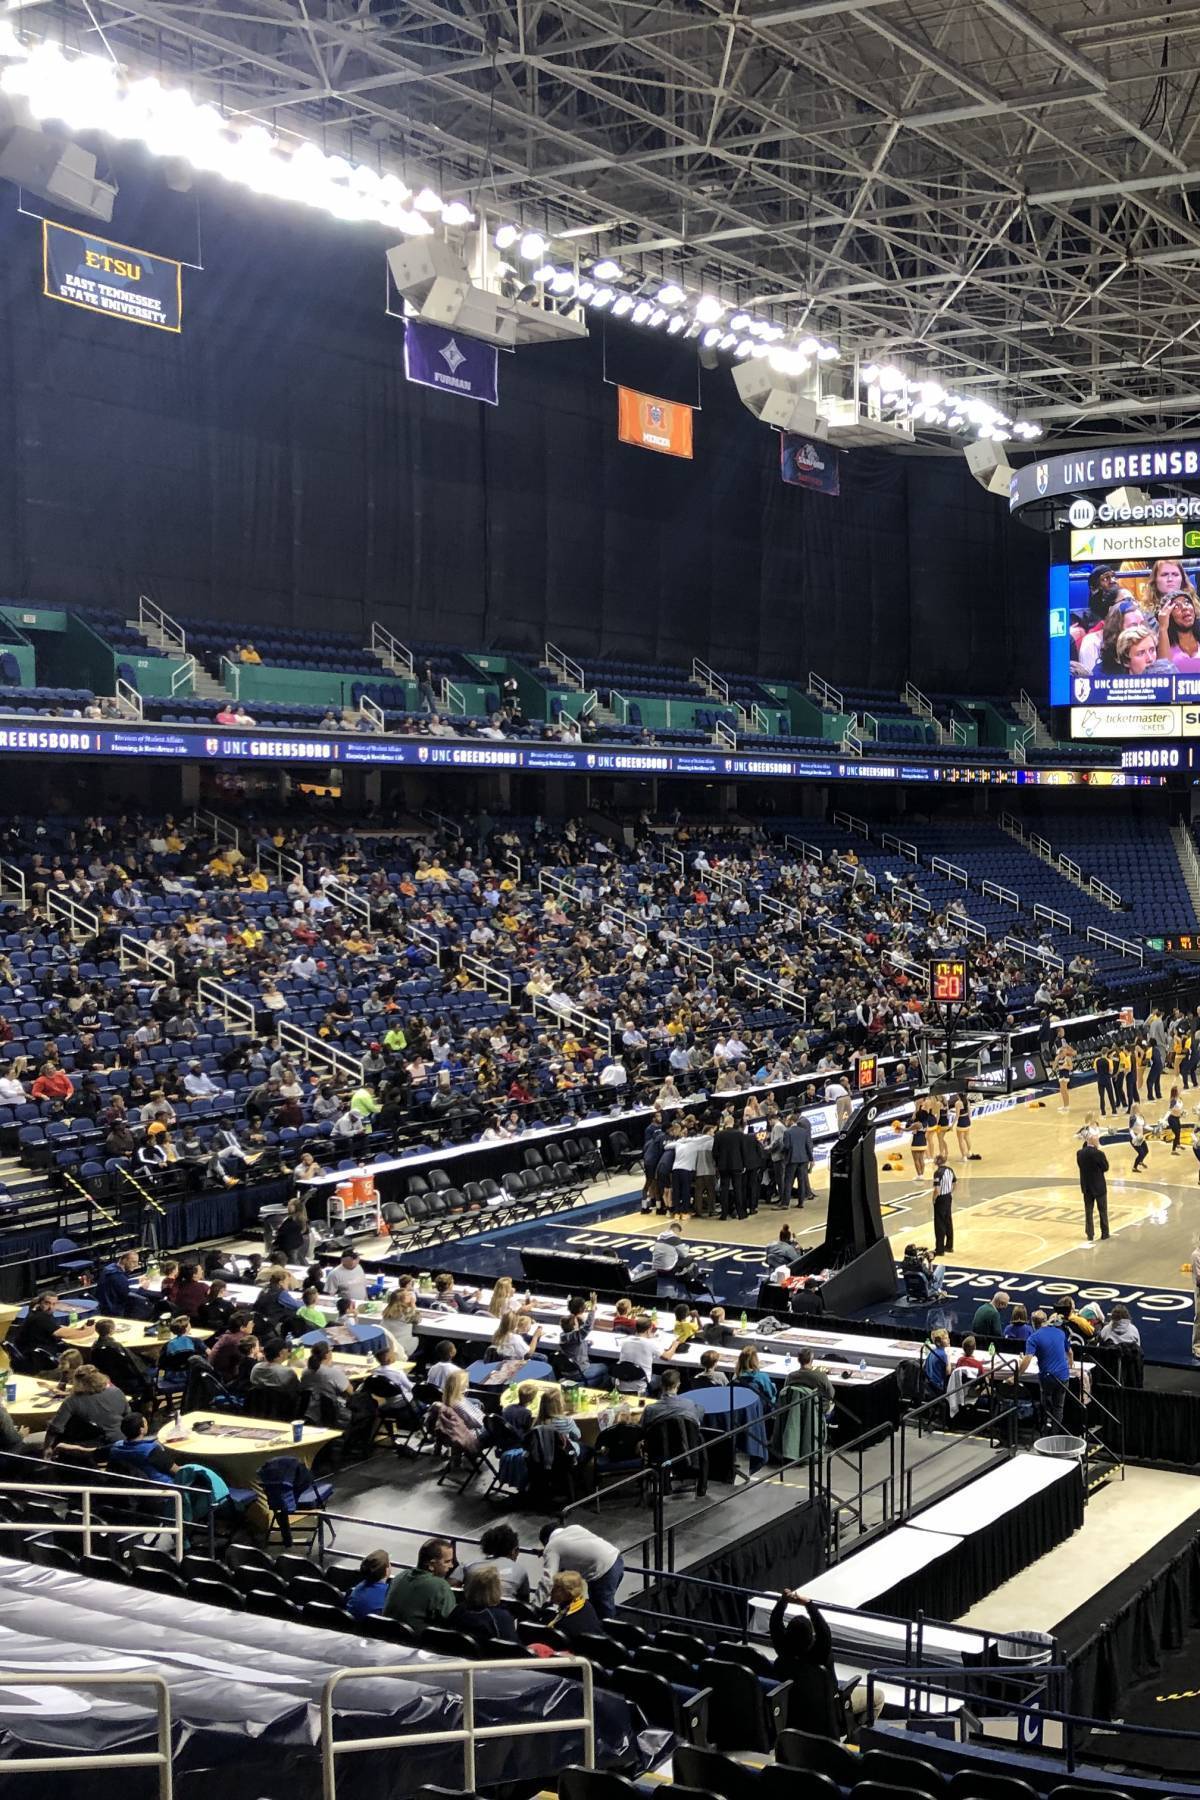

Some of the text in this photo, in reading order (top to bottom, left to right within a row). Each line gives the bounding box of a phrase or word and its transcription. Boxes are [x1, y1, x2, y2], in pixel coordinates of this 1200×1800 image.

[84, 250, 141, 280] ETSU
[65, 273, 162, 310] EAST TENNESSEE
[60, 285, 167, 324] STATE UNIVERSITY
[434, 371, 471, 391] FURMAN
[1064, 460, 1096, 485] UNC
[1103, 535, 1180, 551] NorthState
[1095, 677, 1169, 689] UNC GREENSBORO
[1106, 713, 1168, 723] ticketmaster
[223, 741, 248, 754] UNC
[250, 741, 330, 758] GREENSBORO
[432, 749, 452, 762] UNC
[453, 750, 517, 765] GREENSBORO
[598, 755, 614, 768] UNC
[615, 756, 668, 770] GREENSBORO
[734, 761, 747, 771] UNC
[748, 761, 792, 774] GREENSBORO
[847, 766, 858, 776] UNC
[859, 766, 895, 777] GREENSBORO
[1111, 774, 1126, 785] 28
[937, 963, 963, 975] 17:14
[938, 976, 960, 997] 20
[861, 1071, 872, 1084] 20
[566, 1233, 1193, 1311] Greensb olisum
